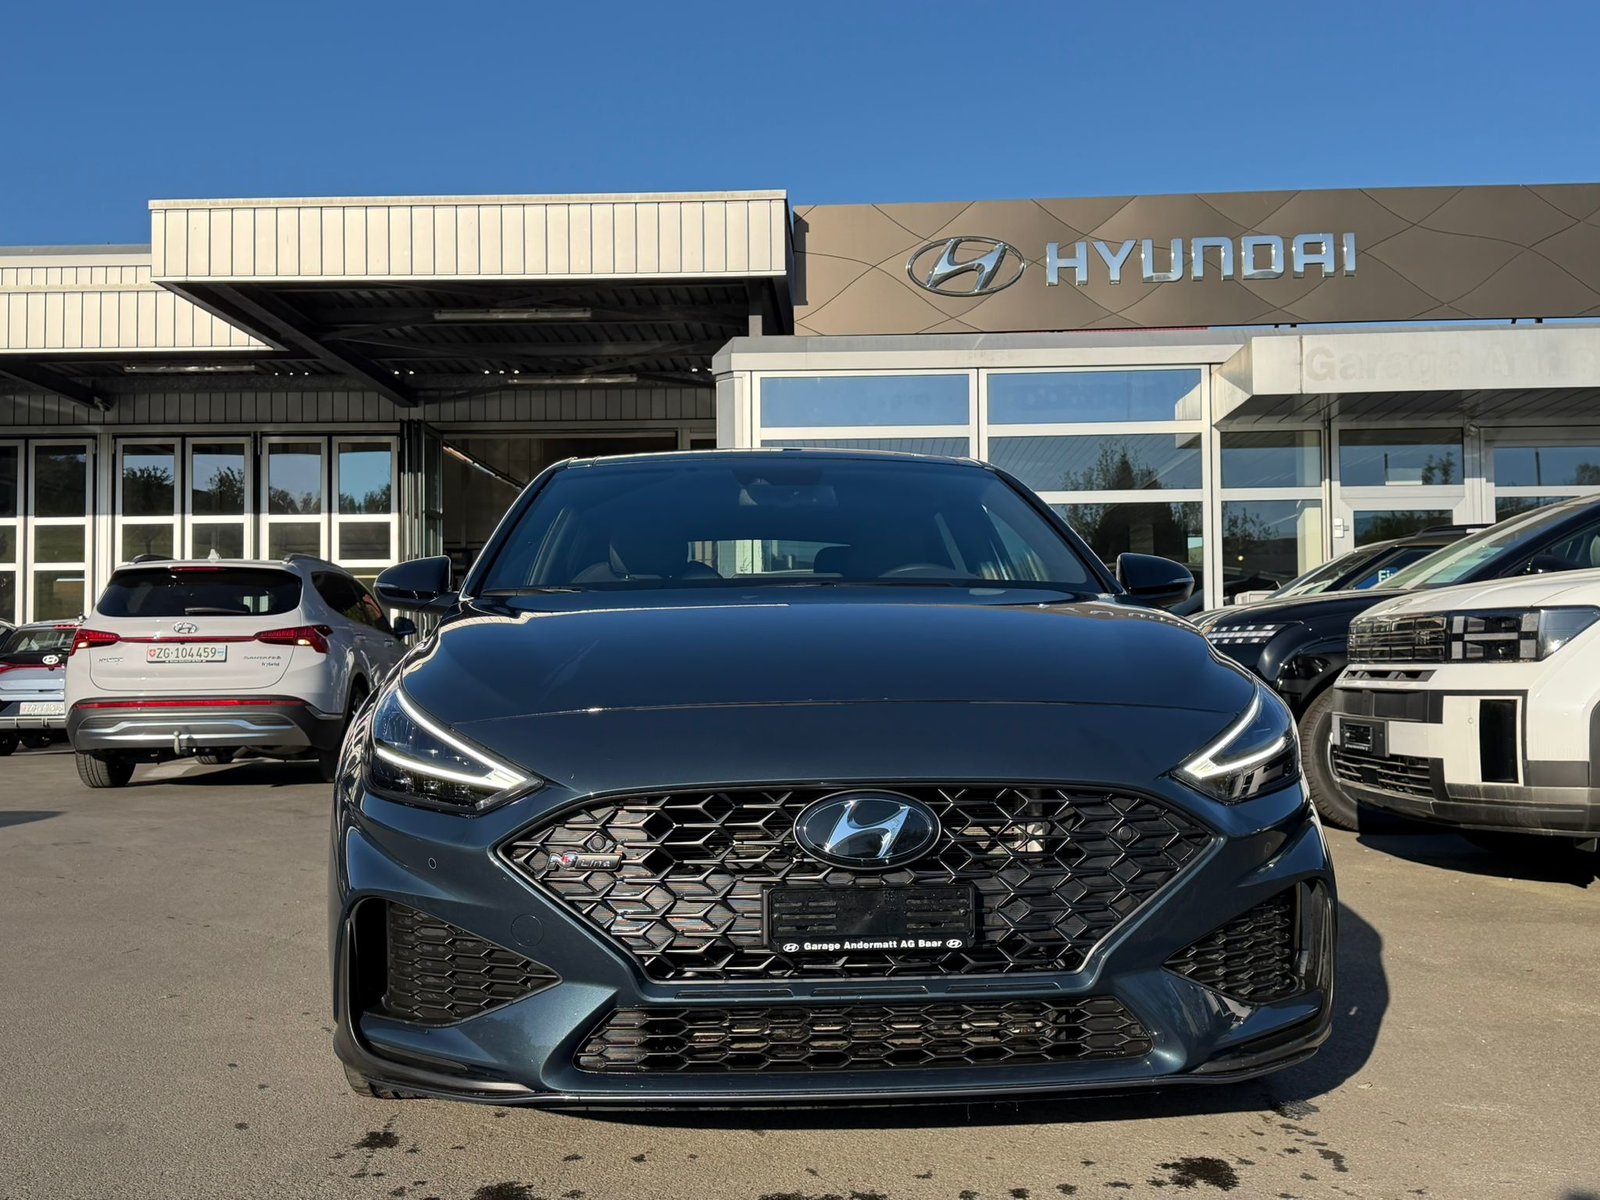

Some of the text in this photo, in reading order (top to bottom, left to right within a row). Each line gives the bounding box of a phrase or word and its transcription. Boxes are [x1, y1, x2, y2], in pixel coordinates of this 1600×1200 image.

[1046, 232, 1355, 286] HYUNDAI
[1305, 346, 1461, 386] Garage
[804, 939, 942, 951] Garage Andermatt AG Baar
